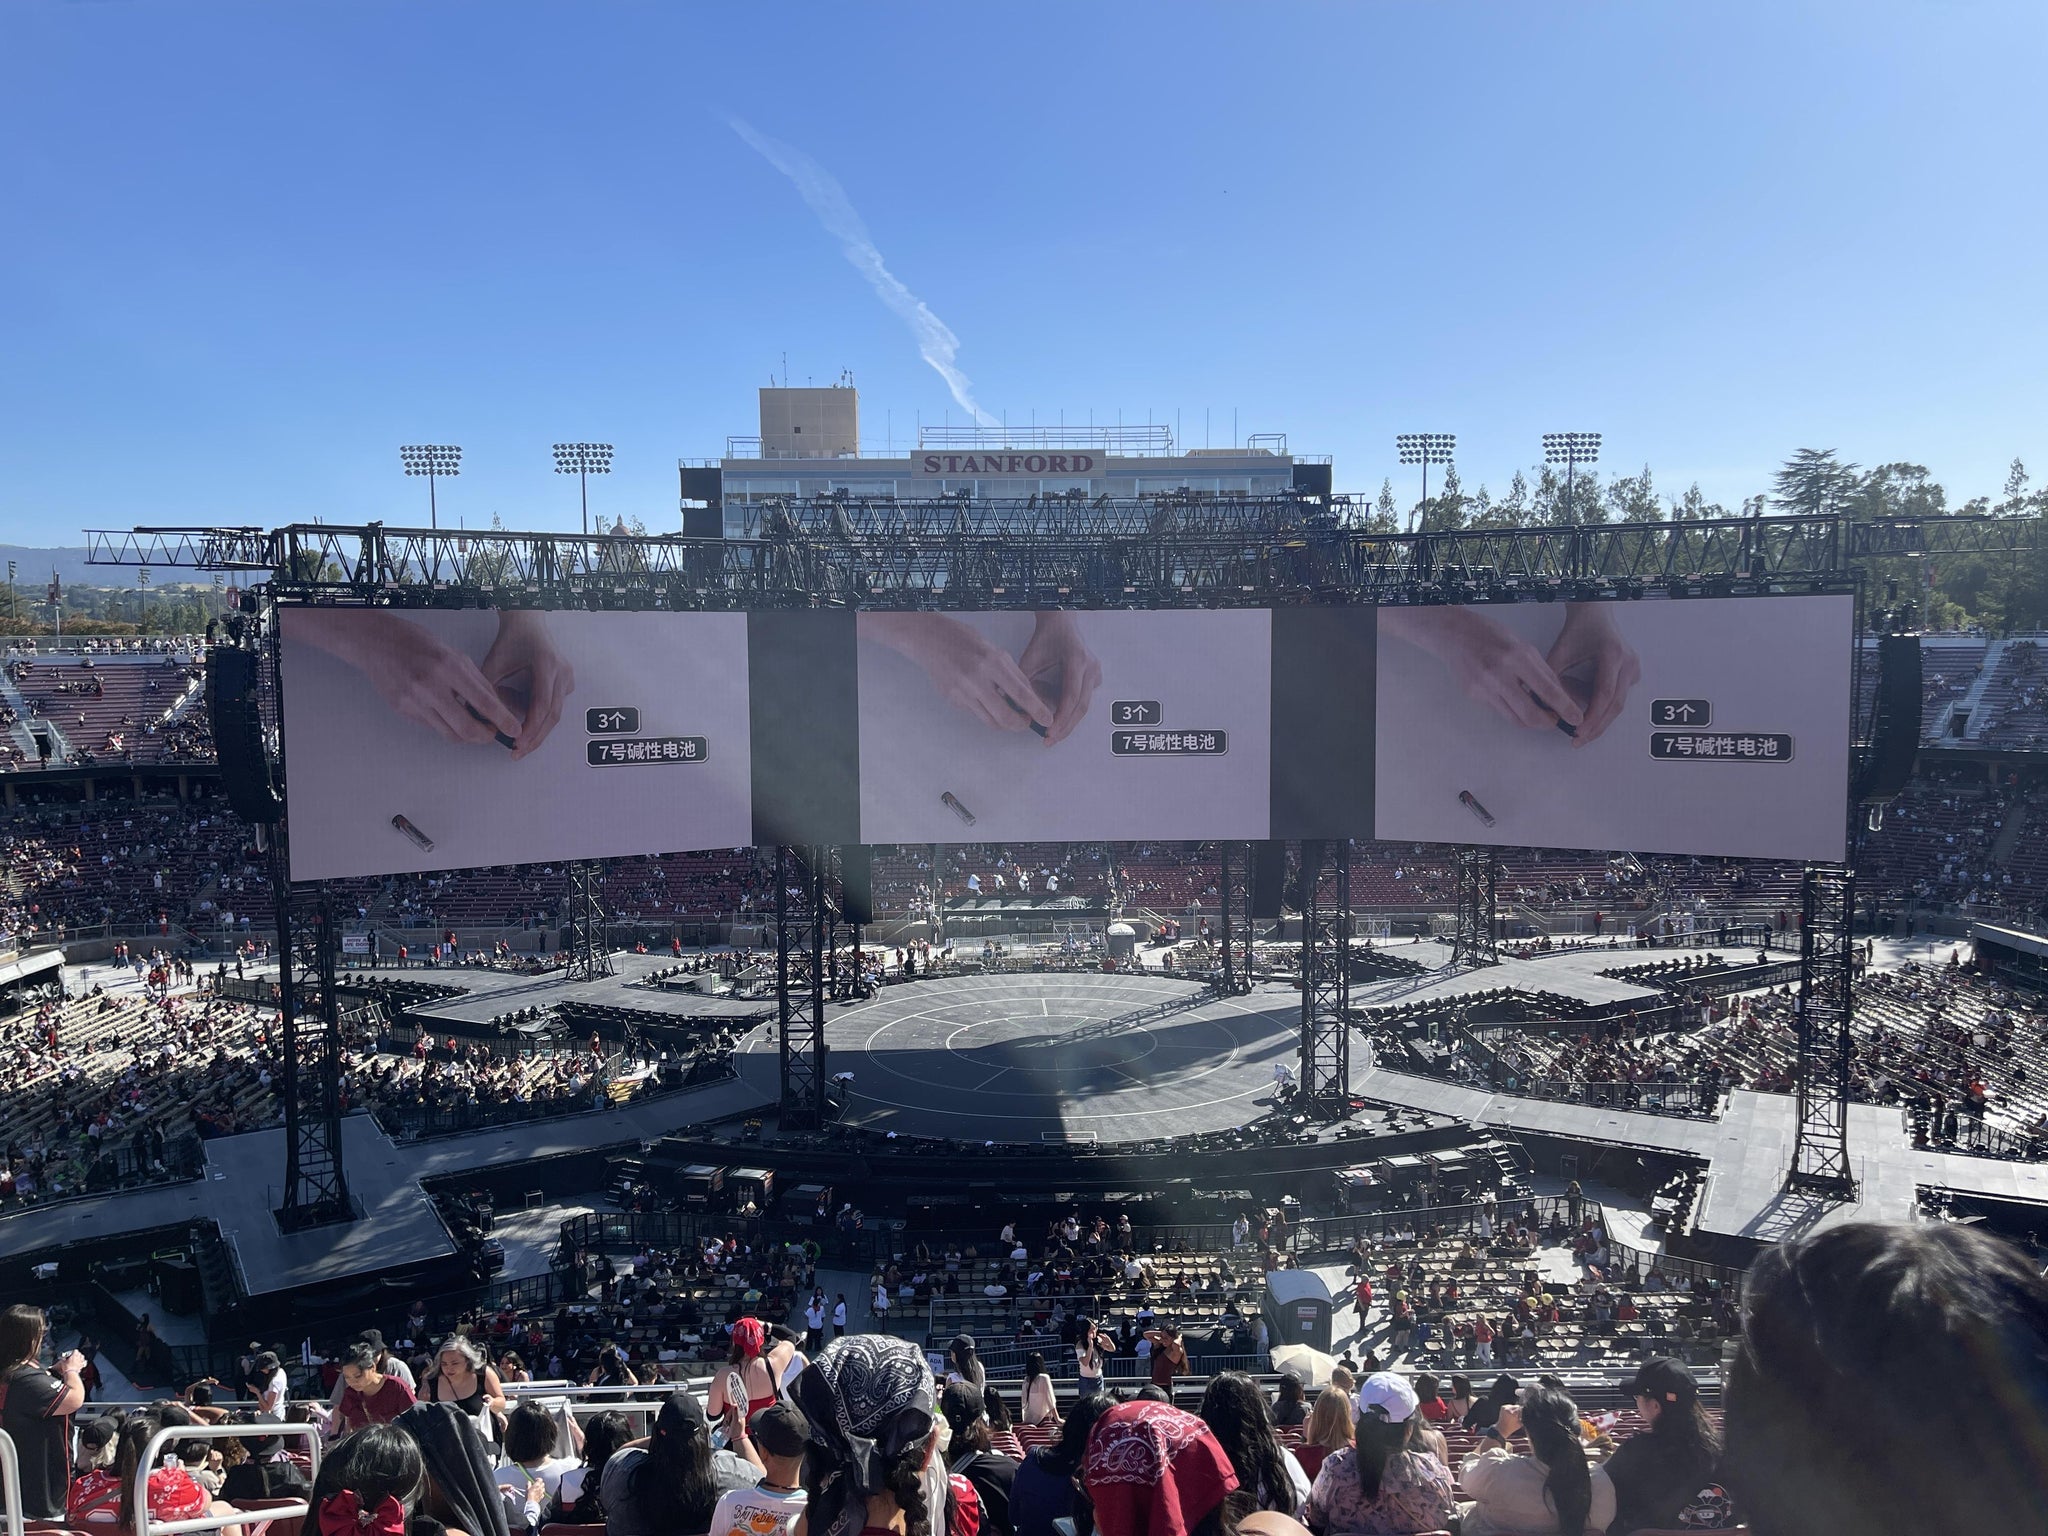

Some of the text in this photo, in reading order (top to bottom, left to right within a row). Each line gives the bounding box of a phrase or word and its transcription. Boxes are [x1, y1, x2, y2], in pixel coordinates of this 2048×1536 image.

[924, 455, 1093, 473] STANFORD
[598, 711, 626, 729] 3个
[1122, 704, 1149, 721] 3个
[1664, 703, 1695, 722] 3个
[599, 740, 696, 761] 7号碱性电池
[1122, 733, 1215, 751] 7号碱性电池
[1664, 736, 1778, 757] 7号碱性电池
